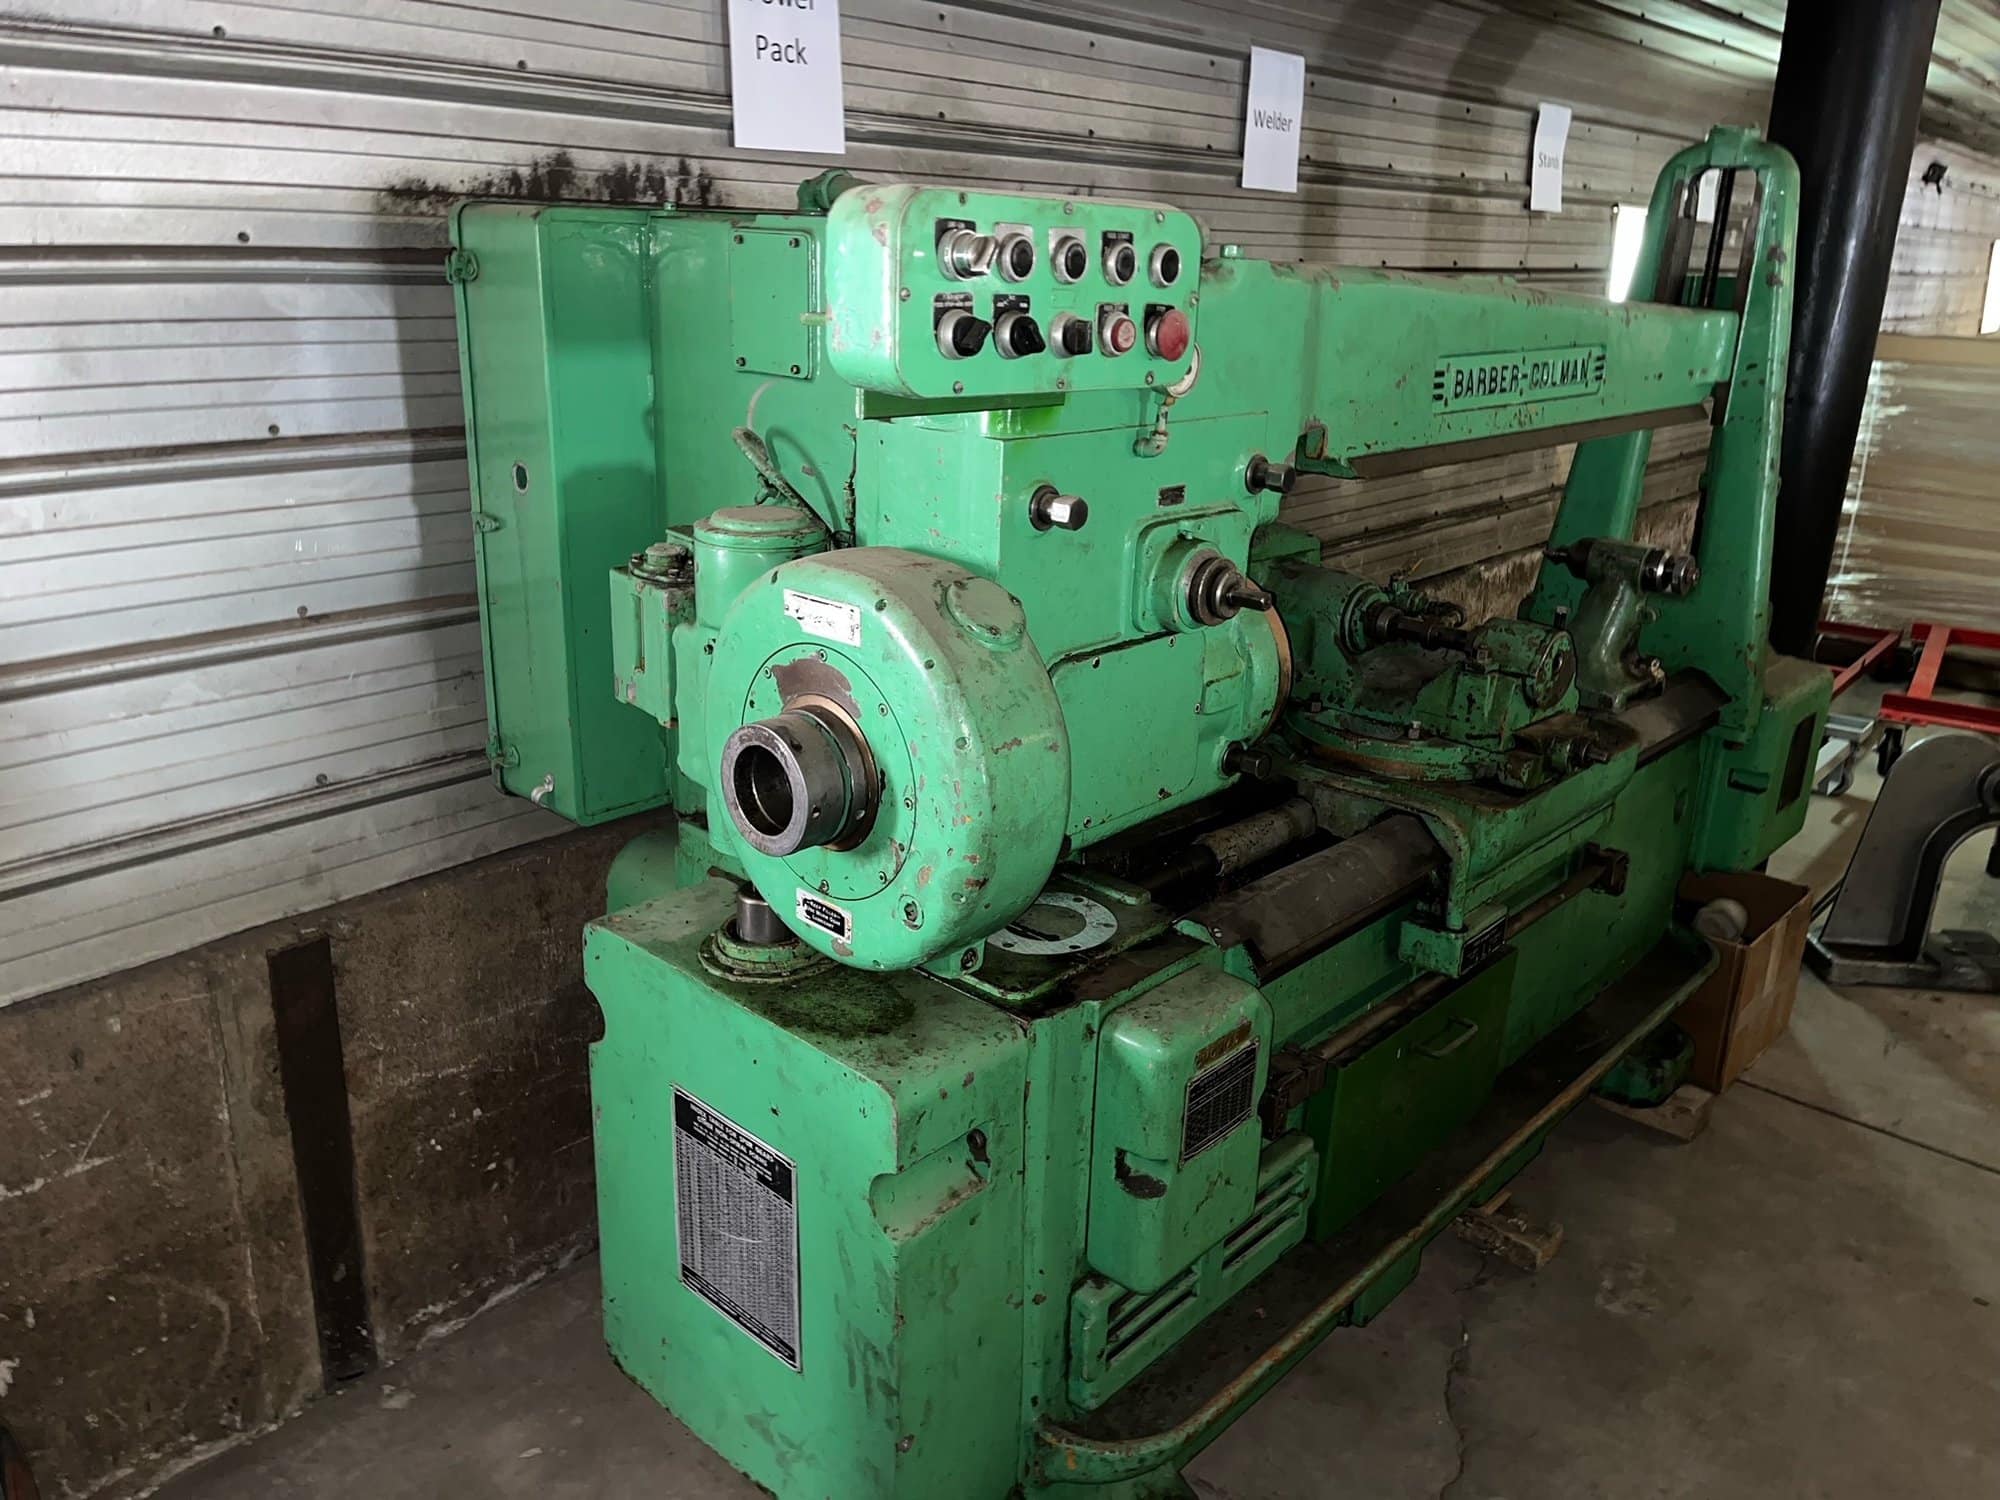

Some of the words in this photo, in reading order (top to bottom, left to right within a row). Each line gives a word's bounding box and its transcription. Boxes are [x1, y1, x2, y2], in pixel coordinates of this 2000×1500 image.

[756, 34, 808, 65] Pack
[1253, 109, 1294, 133] Welder
[1453, 357, 1589, 399] BARBER-COLMAN
